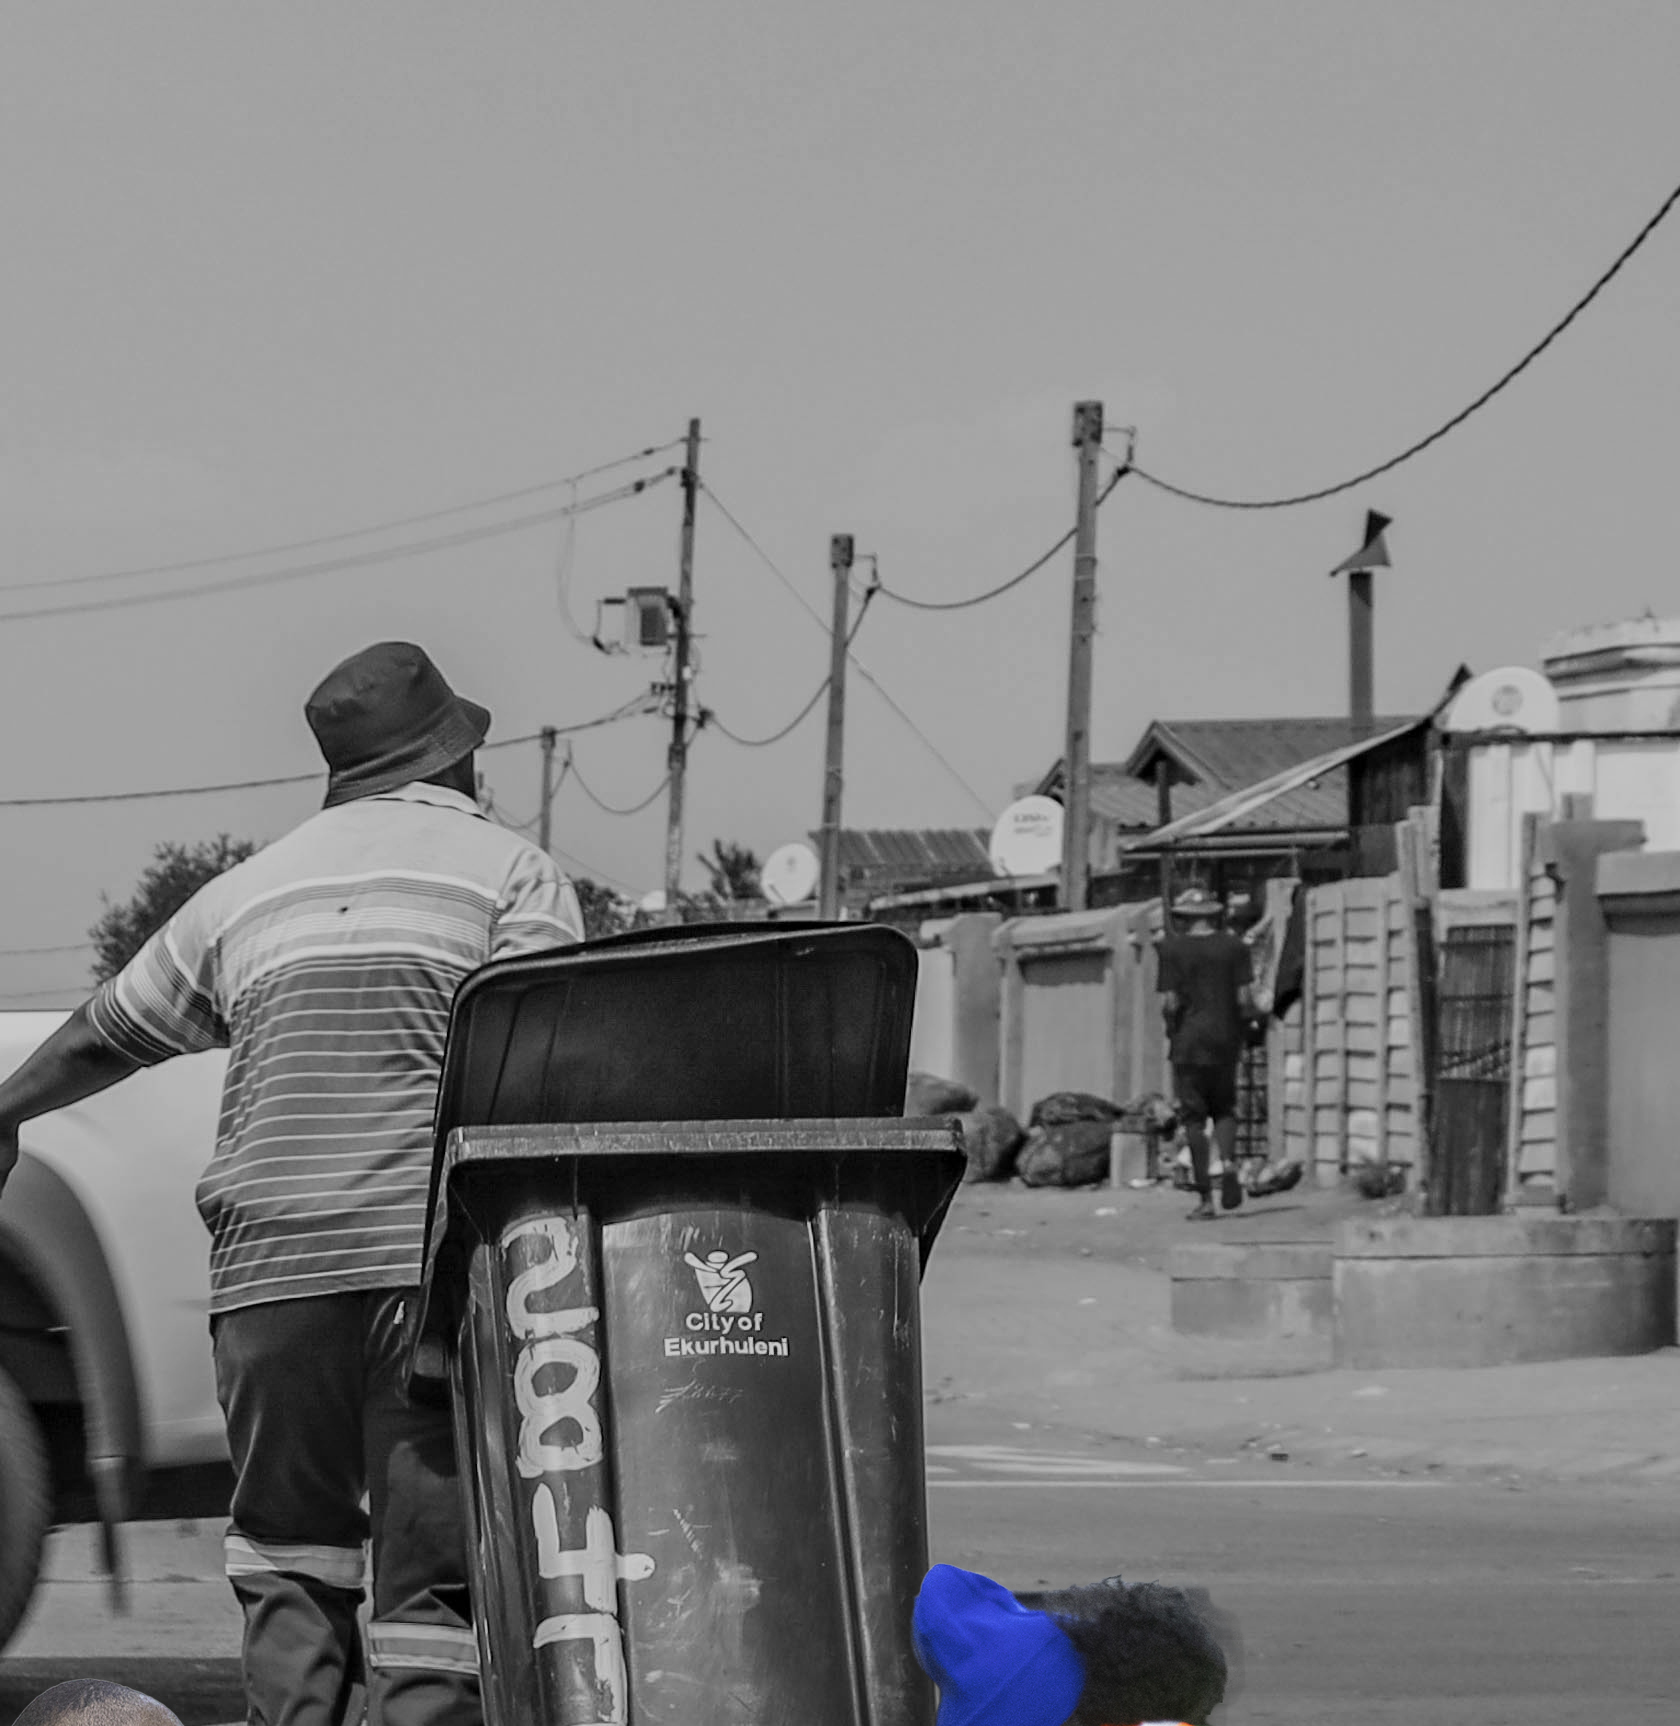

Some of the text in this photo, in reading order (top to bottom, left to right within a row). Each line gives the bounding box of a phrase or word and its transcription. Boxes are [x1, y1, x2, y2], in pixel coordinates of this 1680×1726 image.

[685, 1312, 763, 1335] City of
[663, 1336, 789, 1357] Ekurhuleni
